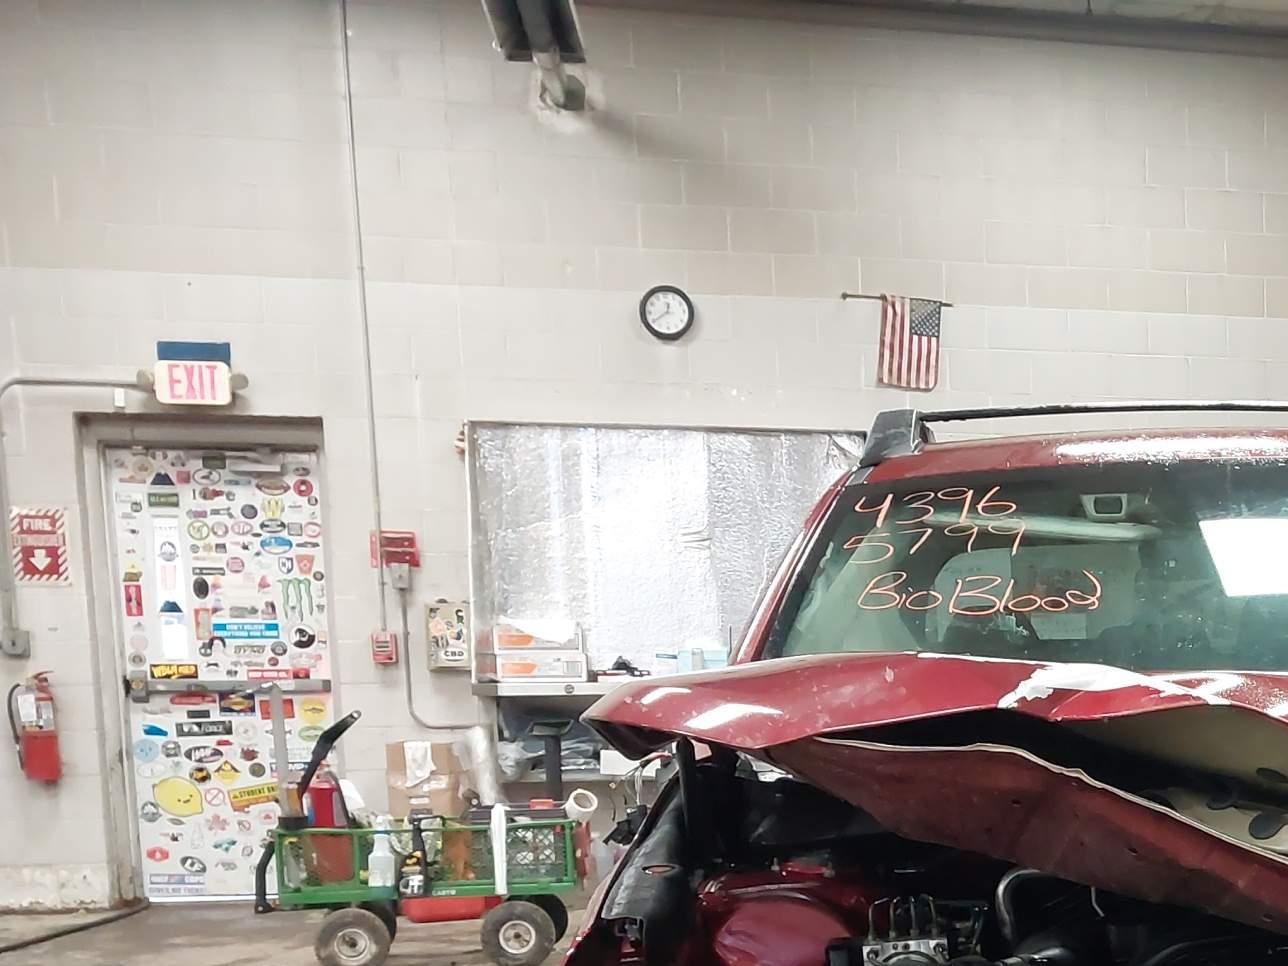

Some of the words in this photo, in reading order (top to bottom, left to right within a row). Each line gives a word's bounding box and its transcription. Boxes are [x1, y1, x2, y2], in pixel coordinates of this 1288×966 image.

[168, 364, 217, 400] EXIT
[22, 518, 53, 531] FIRE
[854, 486, 1017, 529] 4396
[843, 520, 1027, 564] 5799
